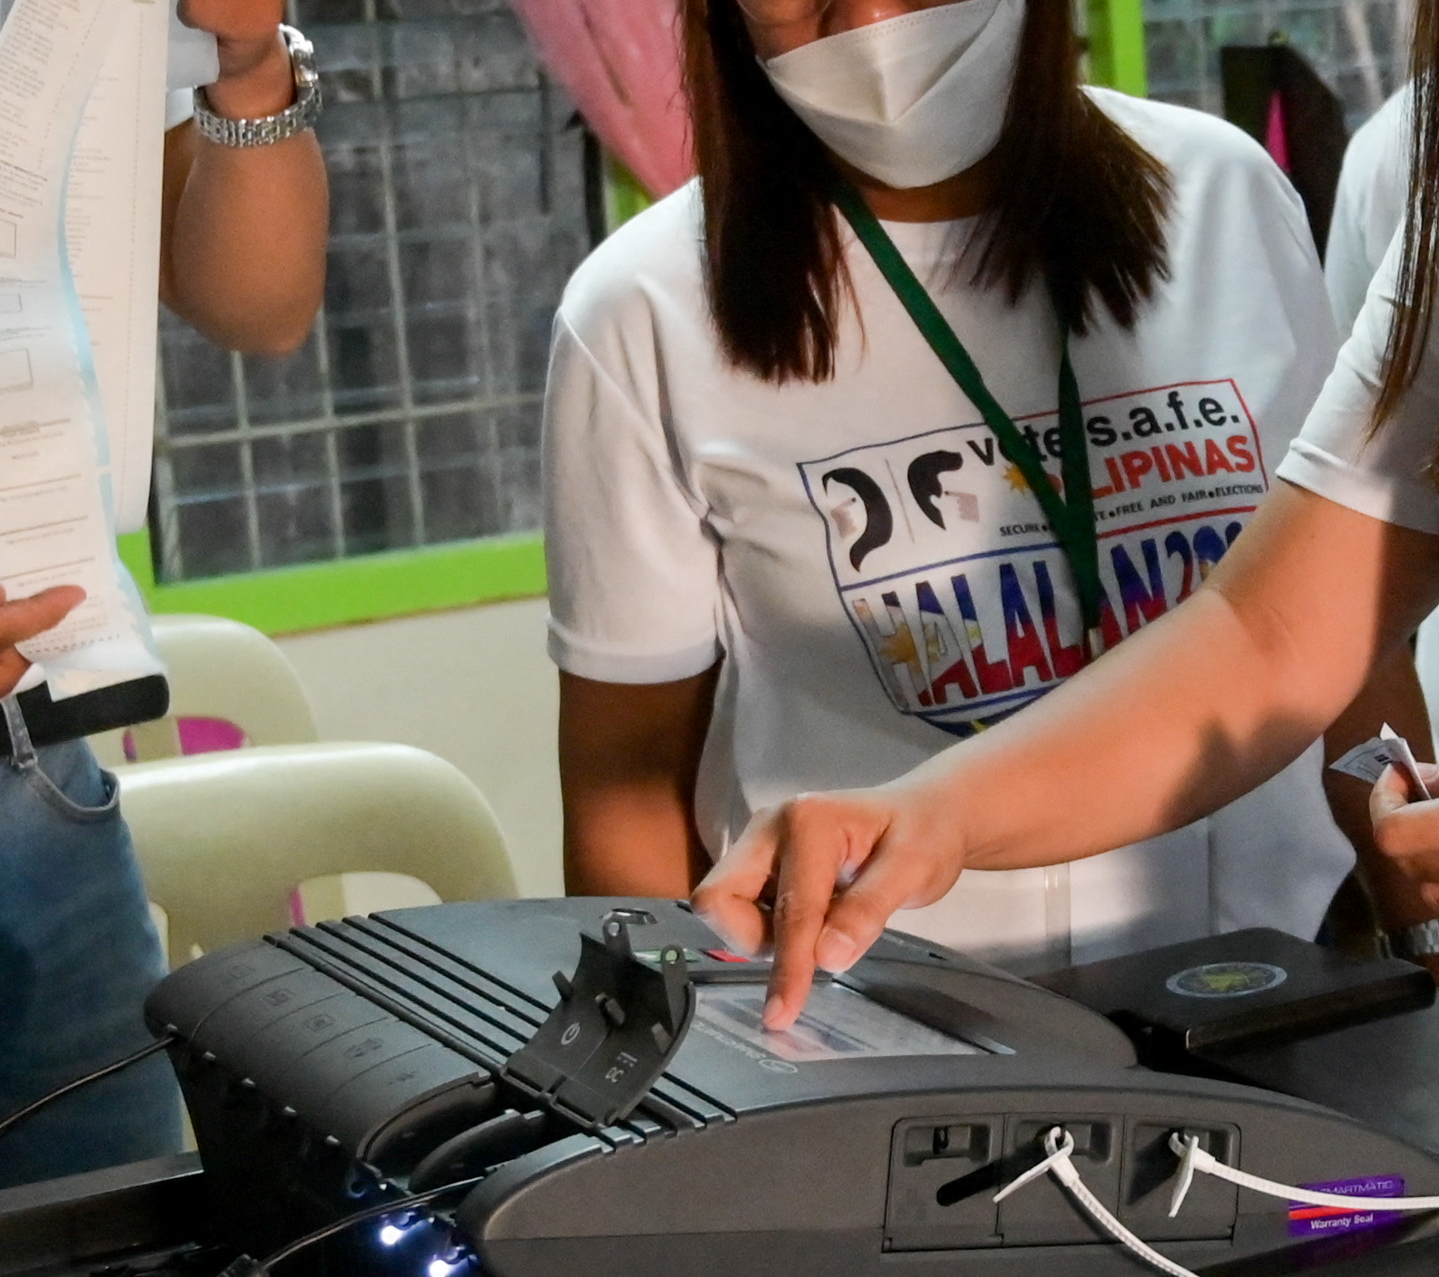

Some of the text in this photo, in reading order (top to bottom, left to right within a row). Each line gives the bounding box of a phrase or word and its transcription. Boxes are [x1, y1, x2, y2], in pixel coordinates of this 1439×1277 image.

[1088, 390, 1241, 448] s.a.f.e.
[1116, 499, 1144, 515] FREE
[1150, 494, 1176, 508] AND
[1182, 489, 1208, 503] FAIR
[1310, 1213, 1374, 1230] Warranty Seal
